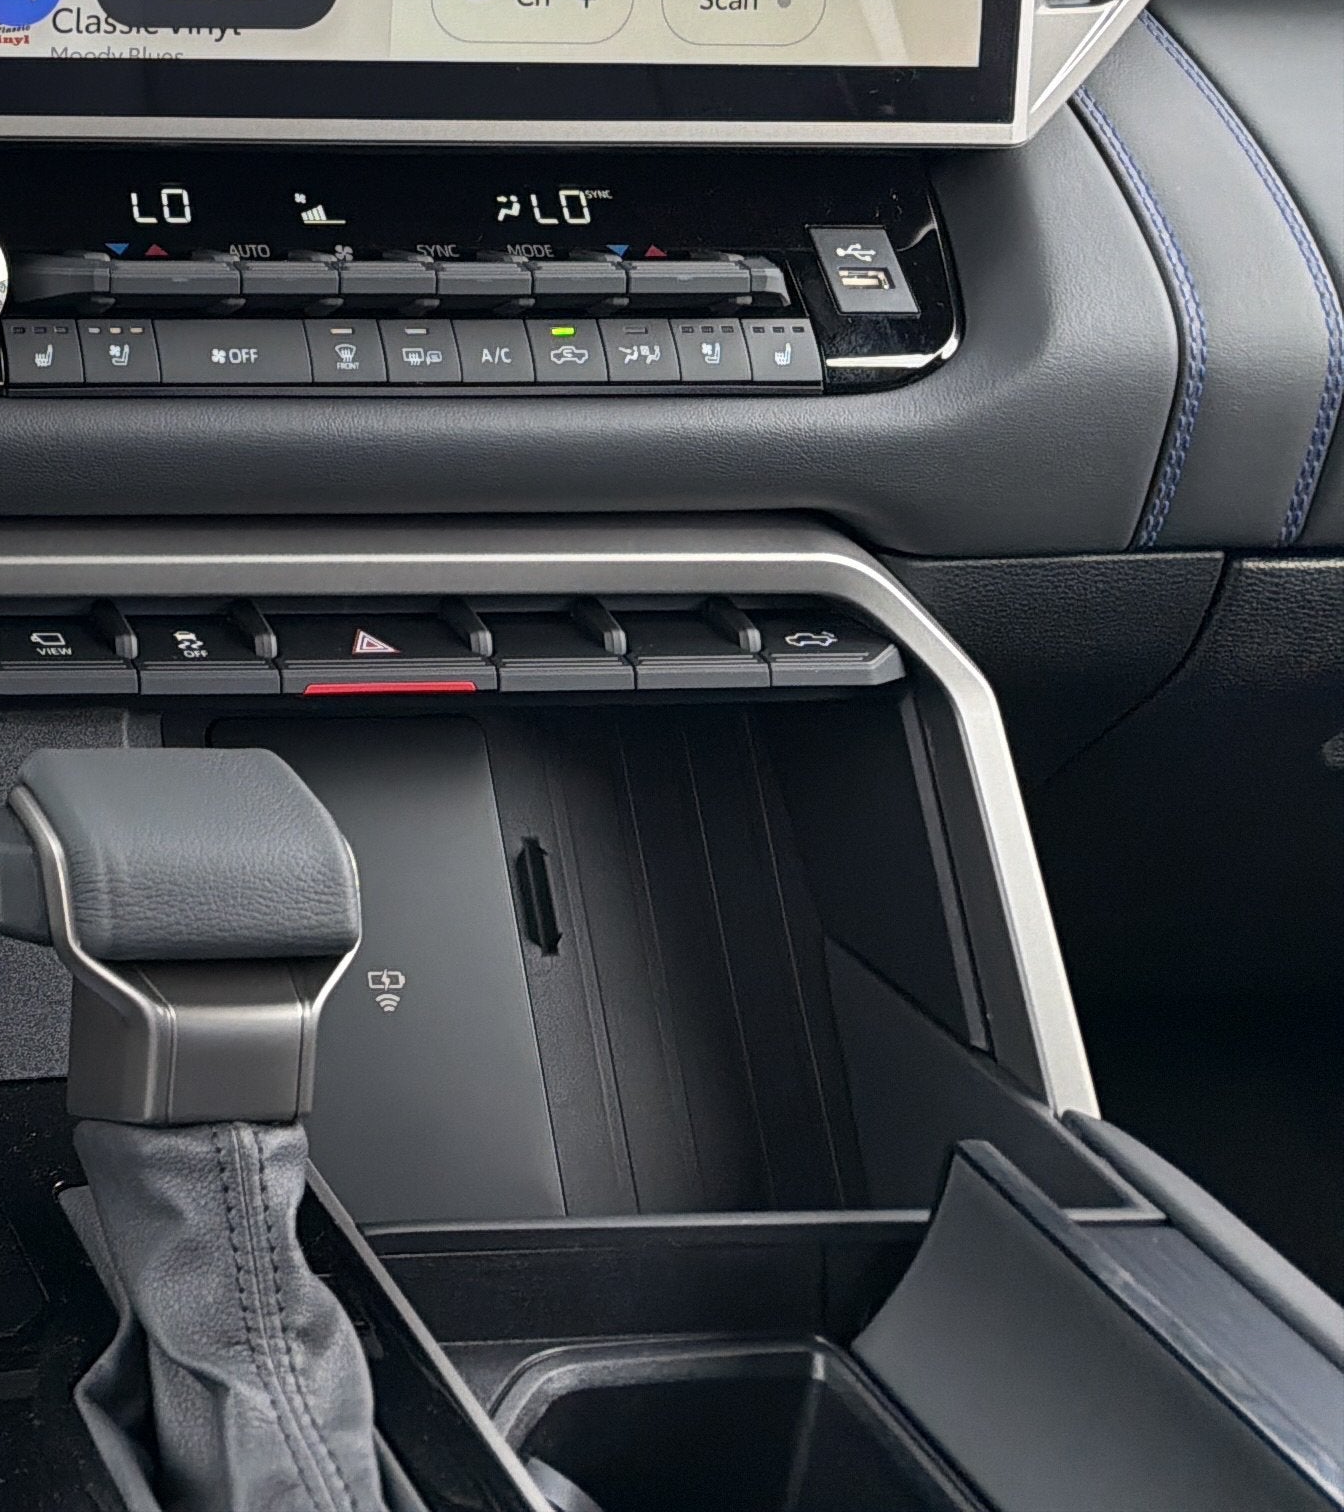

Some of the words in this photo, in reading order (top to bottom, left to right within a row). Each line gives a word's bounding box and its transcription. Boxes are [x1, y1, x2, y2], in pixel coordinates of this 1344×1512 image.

[585, 188, 614, 200] SYNC
[228, 243, 271, 260] AUTO
[416, 243, 460, 259] SYNC
[507, 244, 554, 259] MODE
[228, 348, 259, 364] OFF
[481, 346, 512, 365] A/C
[336, 360, 361, 371] FRONT
[35, 646, 73, 657] VIEW
[183, 648, 209, 659] OFF
